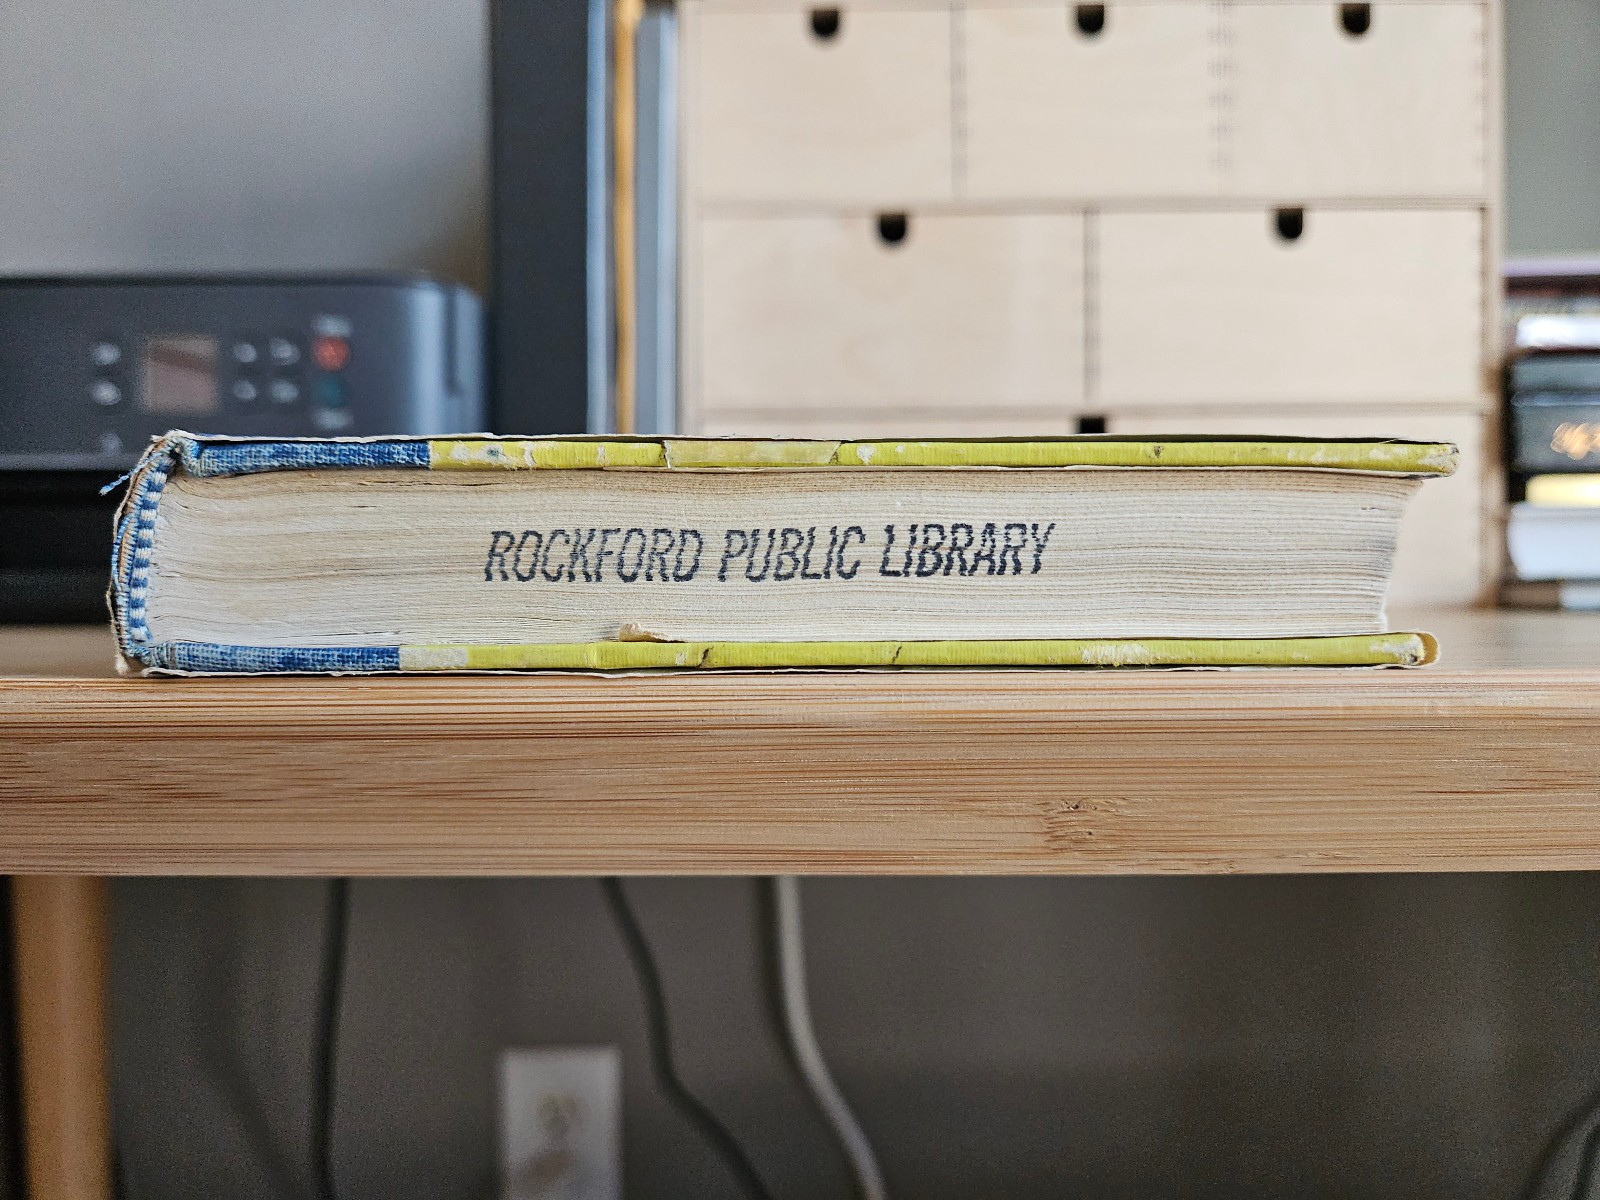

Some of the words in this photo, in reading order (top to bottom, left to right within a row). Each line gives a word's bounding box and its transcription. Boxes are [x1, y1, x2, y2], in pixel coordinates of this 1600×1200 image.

[484, 527, 704, 583] ROCKFORD
[717, 526, 866, 583] PUBLIC
[879, 522, 1057, 578] LIBRARY
